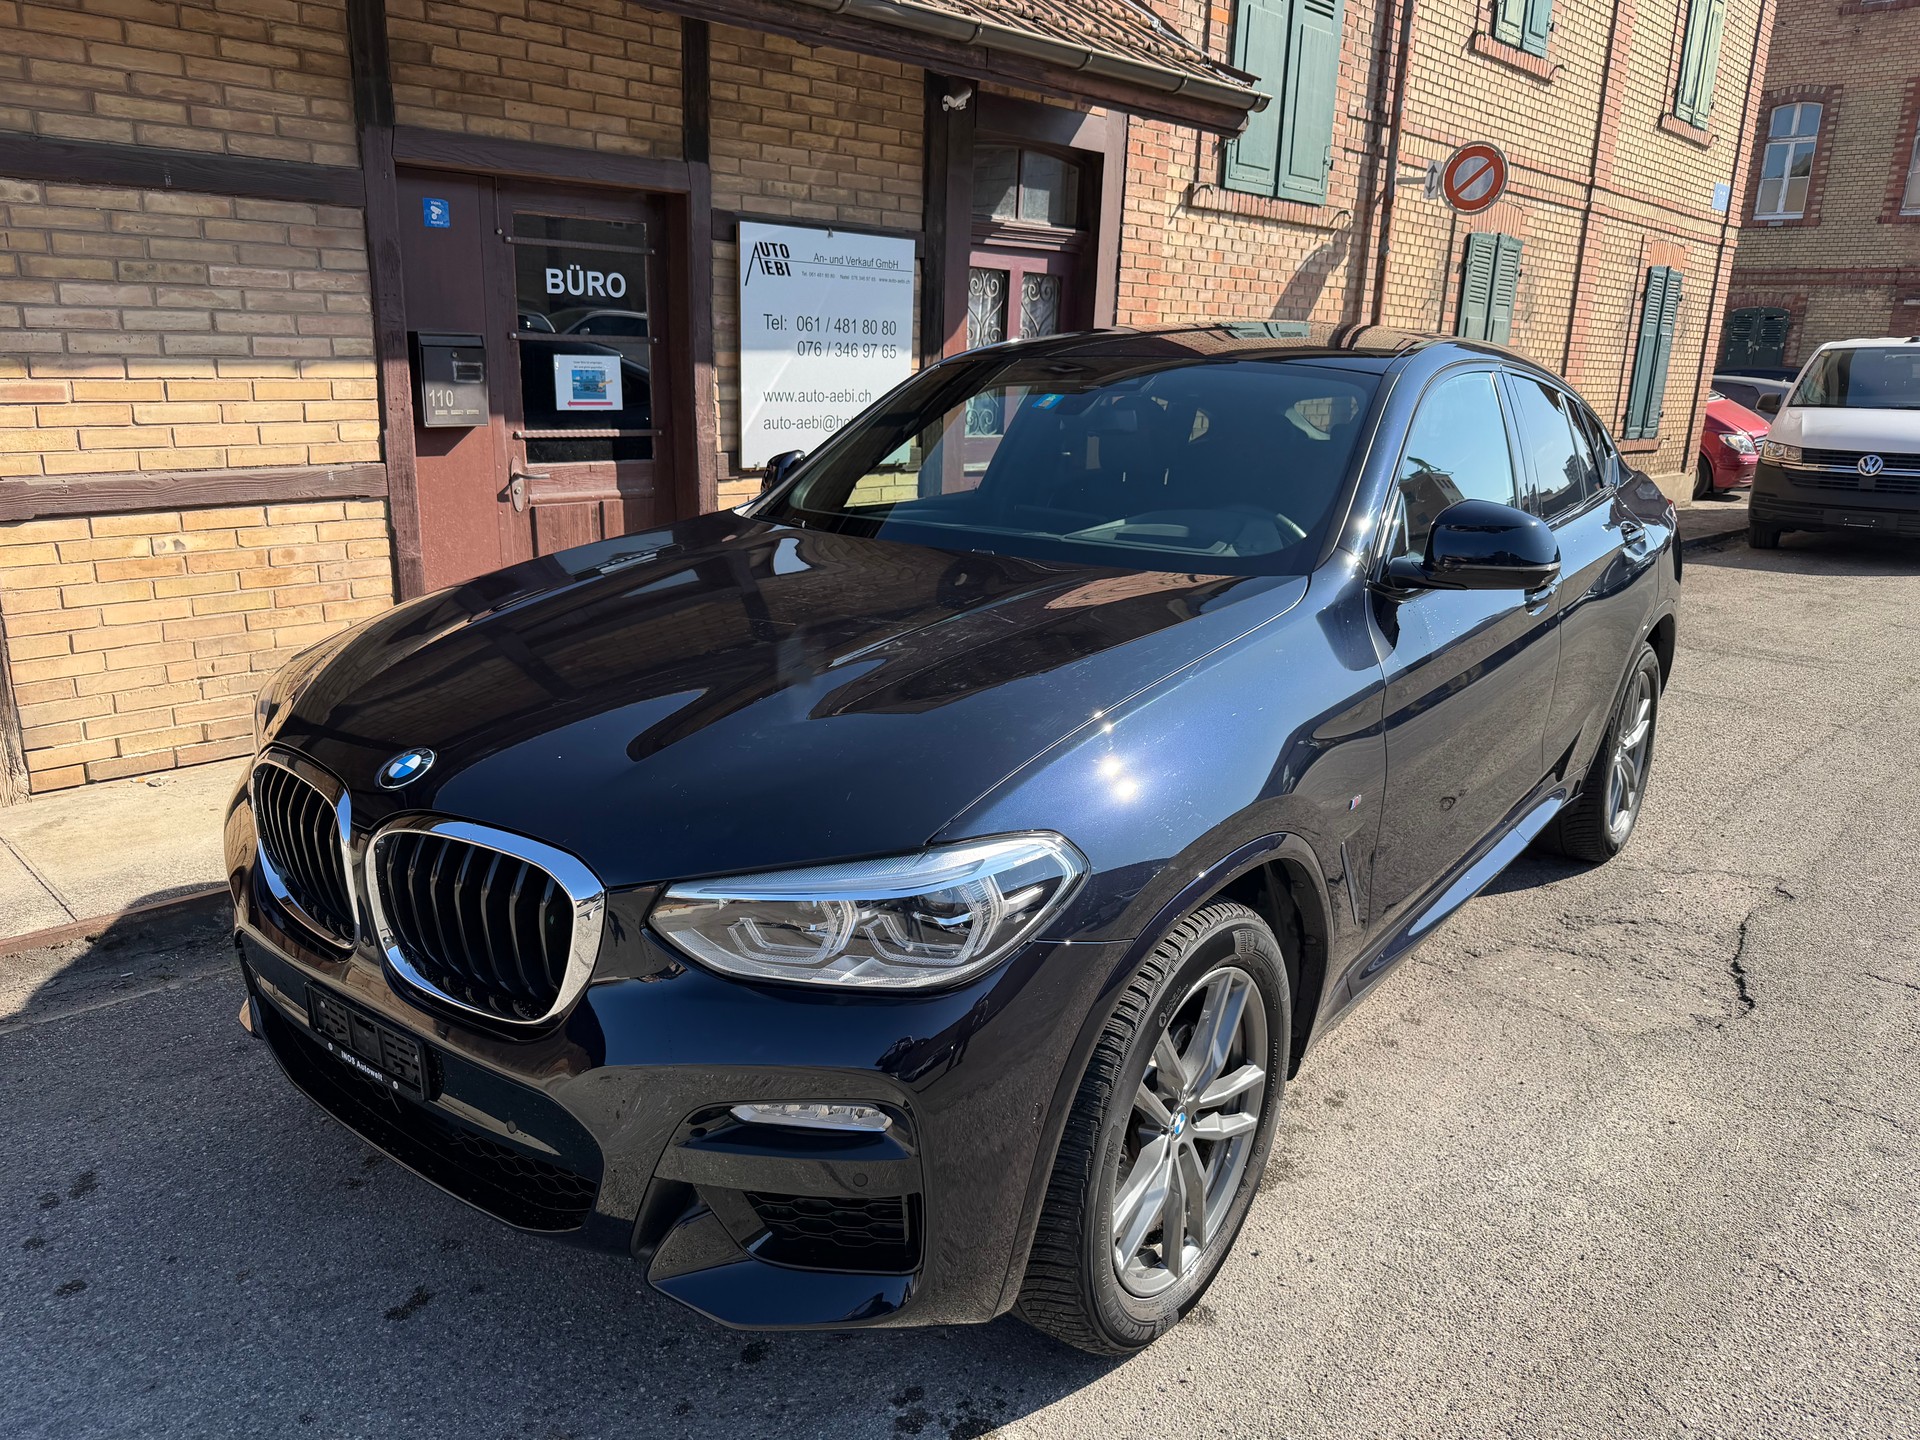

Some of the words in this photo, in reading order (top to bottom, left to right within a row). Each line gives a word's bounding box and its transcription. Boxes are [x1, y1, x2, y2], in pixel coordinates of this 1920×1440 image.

[813, 253, 827, 262] An-
[829, 255, 844, 264] und
[846, 256, 874, 267] Verkauf
[876, 259, 899, 269] GmbH
[545, 264, 627, 298] BÜRO
[763, 313, 787, 331] Tel:
[796, 315, 820, 332] 061
[825, 317, 831, 333] /
[833, 318, 857, 334] 481
[862, 319, 878, 335] 80
[881, 320, 897, 336] 80
[797, 340, 822, 357] 076
[826, 342, 831, 357] /
[834, 341, 859, 358] 346
[862, 343, 878, 358] 97
[881, 343, 897, 359] 65
[429, 389, 454, 407] 110
[763, 388, 872, 403] www.auto-aebi.ch
[763, 414, 855, 433] auto-aebi@ho
